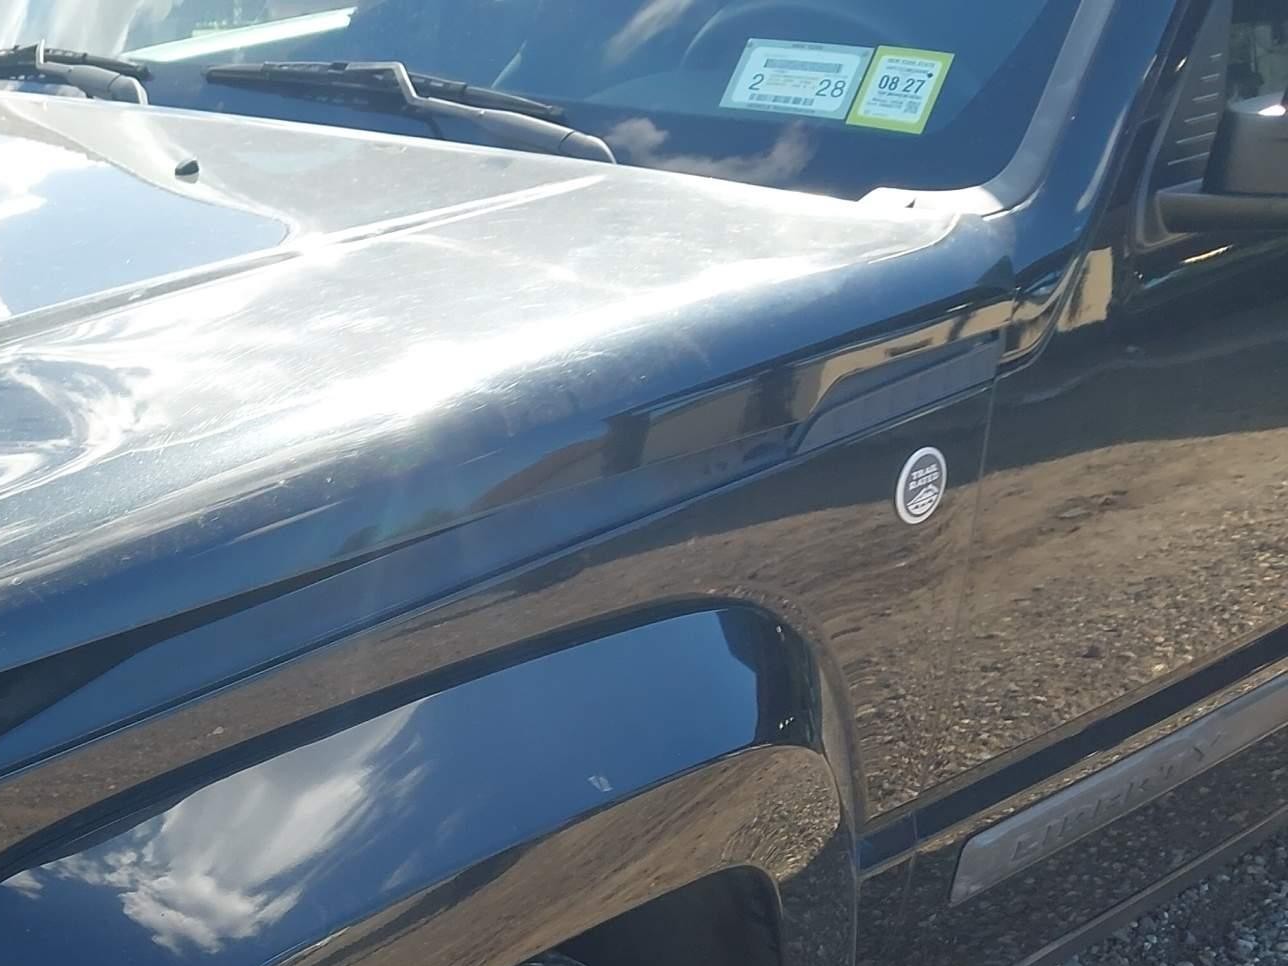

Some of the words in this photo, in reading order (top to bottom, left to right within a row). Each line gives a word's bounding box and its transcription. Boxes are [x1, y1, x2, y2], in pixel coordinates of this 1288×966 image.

[748, 73, 765, 91] 2
[815, 78, 847, 98] 28
[878, 74, 900, 91] 08
[902, 78, 926, 94] 27
